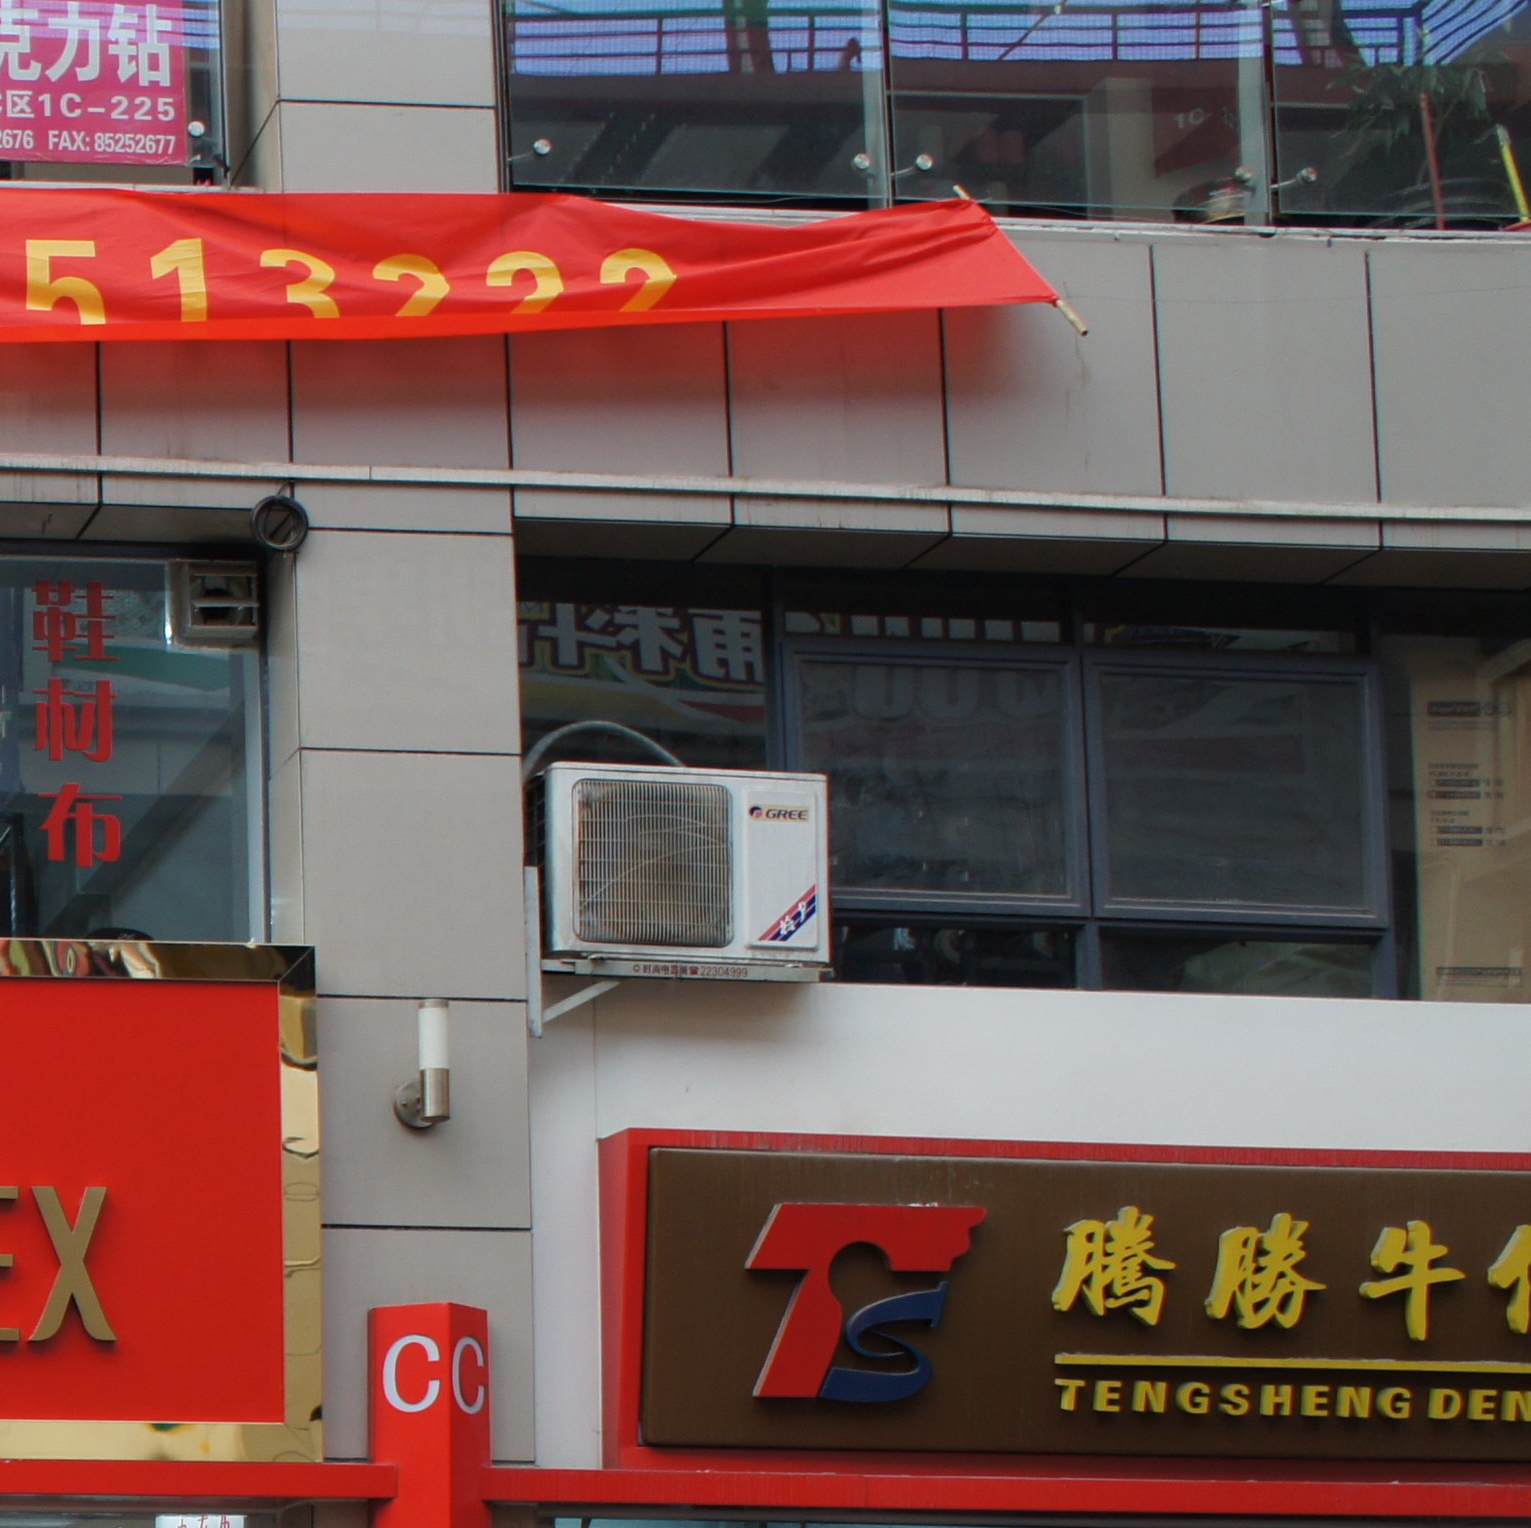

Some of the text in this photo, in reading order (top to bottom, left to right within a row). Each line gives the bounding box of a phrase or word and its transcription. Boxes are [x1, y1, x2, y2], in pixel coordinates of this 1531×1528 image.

[48, 130, 90, 151] FAX:
[94, 132, 176, 154] 85252677
[30, 580, 124, 868] 鞋材布
[765, 808, 809, 820] GREE
[1054, 1377, 1411, 1421] TENGSHENG
